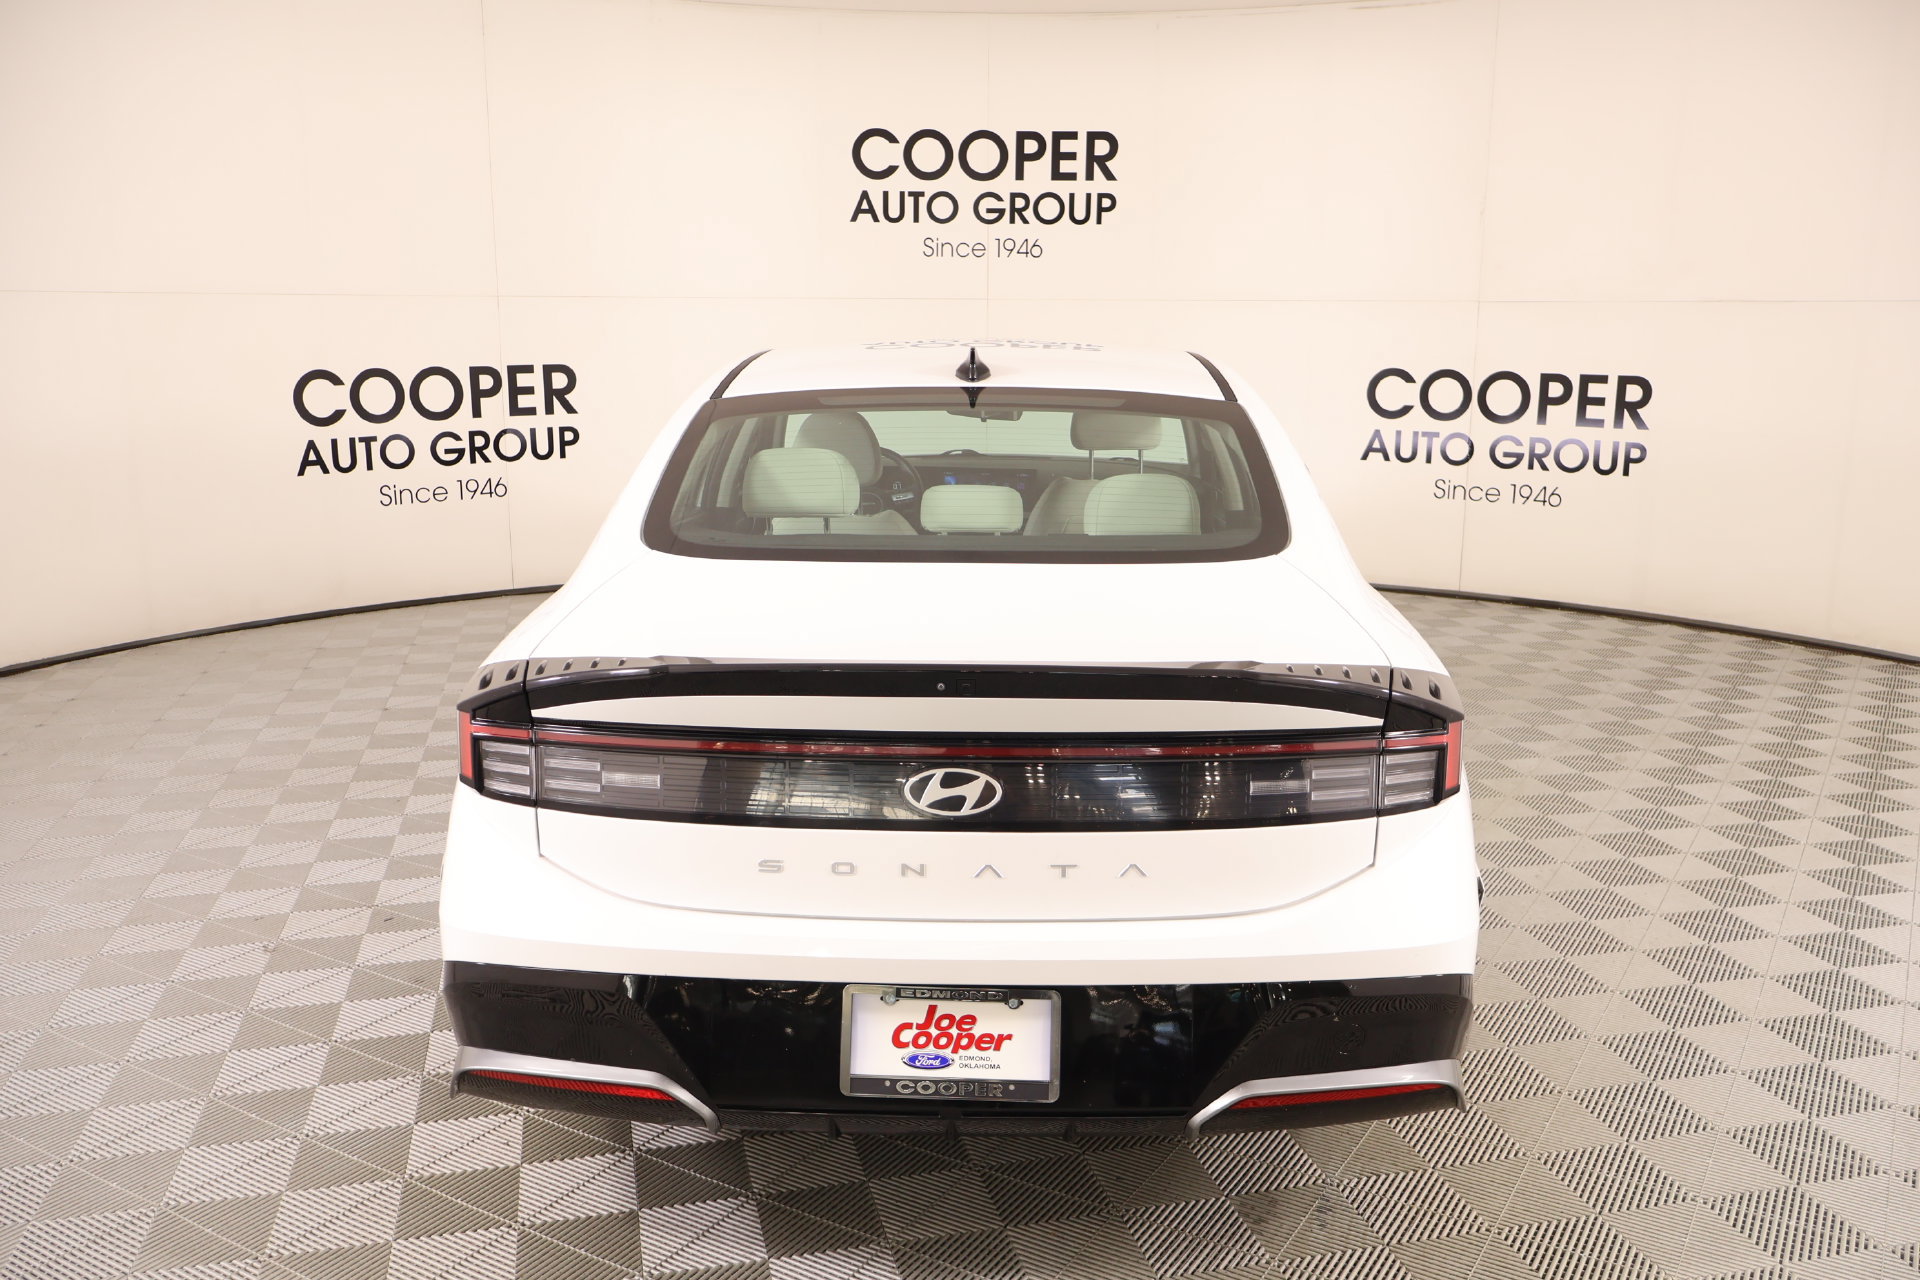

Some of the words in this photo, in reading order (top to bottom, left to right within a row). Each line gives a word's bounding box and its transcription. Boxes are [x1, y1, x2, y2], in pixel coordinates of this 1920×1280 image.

[851, 127, 1120, 182] COOPER
[849, 189, 960, 225] AUTO
[972, 191, 1118, 226] GROUP
[922, 236, 987, 259] Since
[994, 237, 1044, 259] 1946
[292, 363, 580, 428] COOPER
[1366, 367, 1654, 431] COOPER
[296, 433, 416, 477] AUTO
[429, 425, 581, 467] GROUP
[1359, 428, 1475, 467] AUTO
[1488, 434, 1648, 478] GROUP
[379, 483, 449, 507] Since
[456, 476, 508, 501] 1946
[1433, 478, 1501, 504] Since
[1510, 483, 1563, 508] 1946
[757, 858, 1149, 880] SONATA
[900, 988, 1004, 1000] EDMOND
[915, 1004, 978, 1032] Joe
[891, 1022, 1013, 1054] Cooper
[915, 1054, 941, 1066] Ford
[958, 1062, 1001, 1070] OKLAHOMA
[895, 1080, 1004, 1097] COOPER
